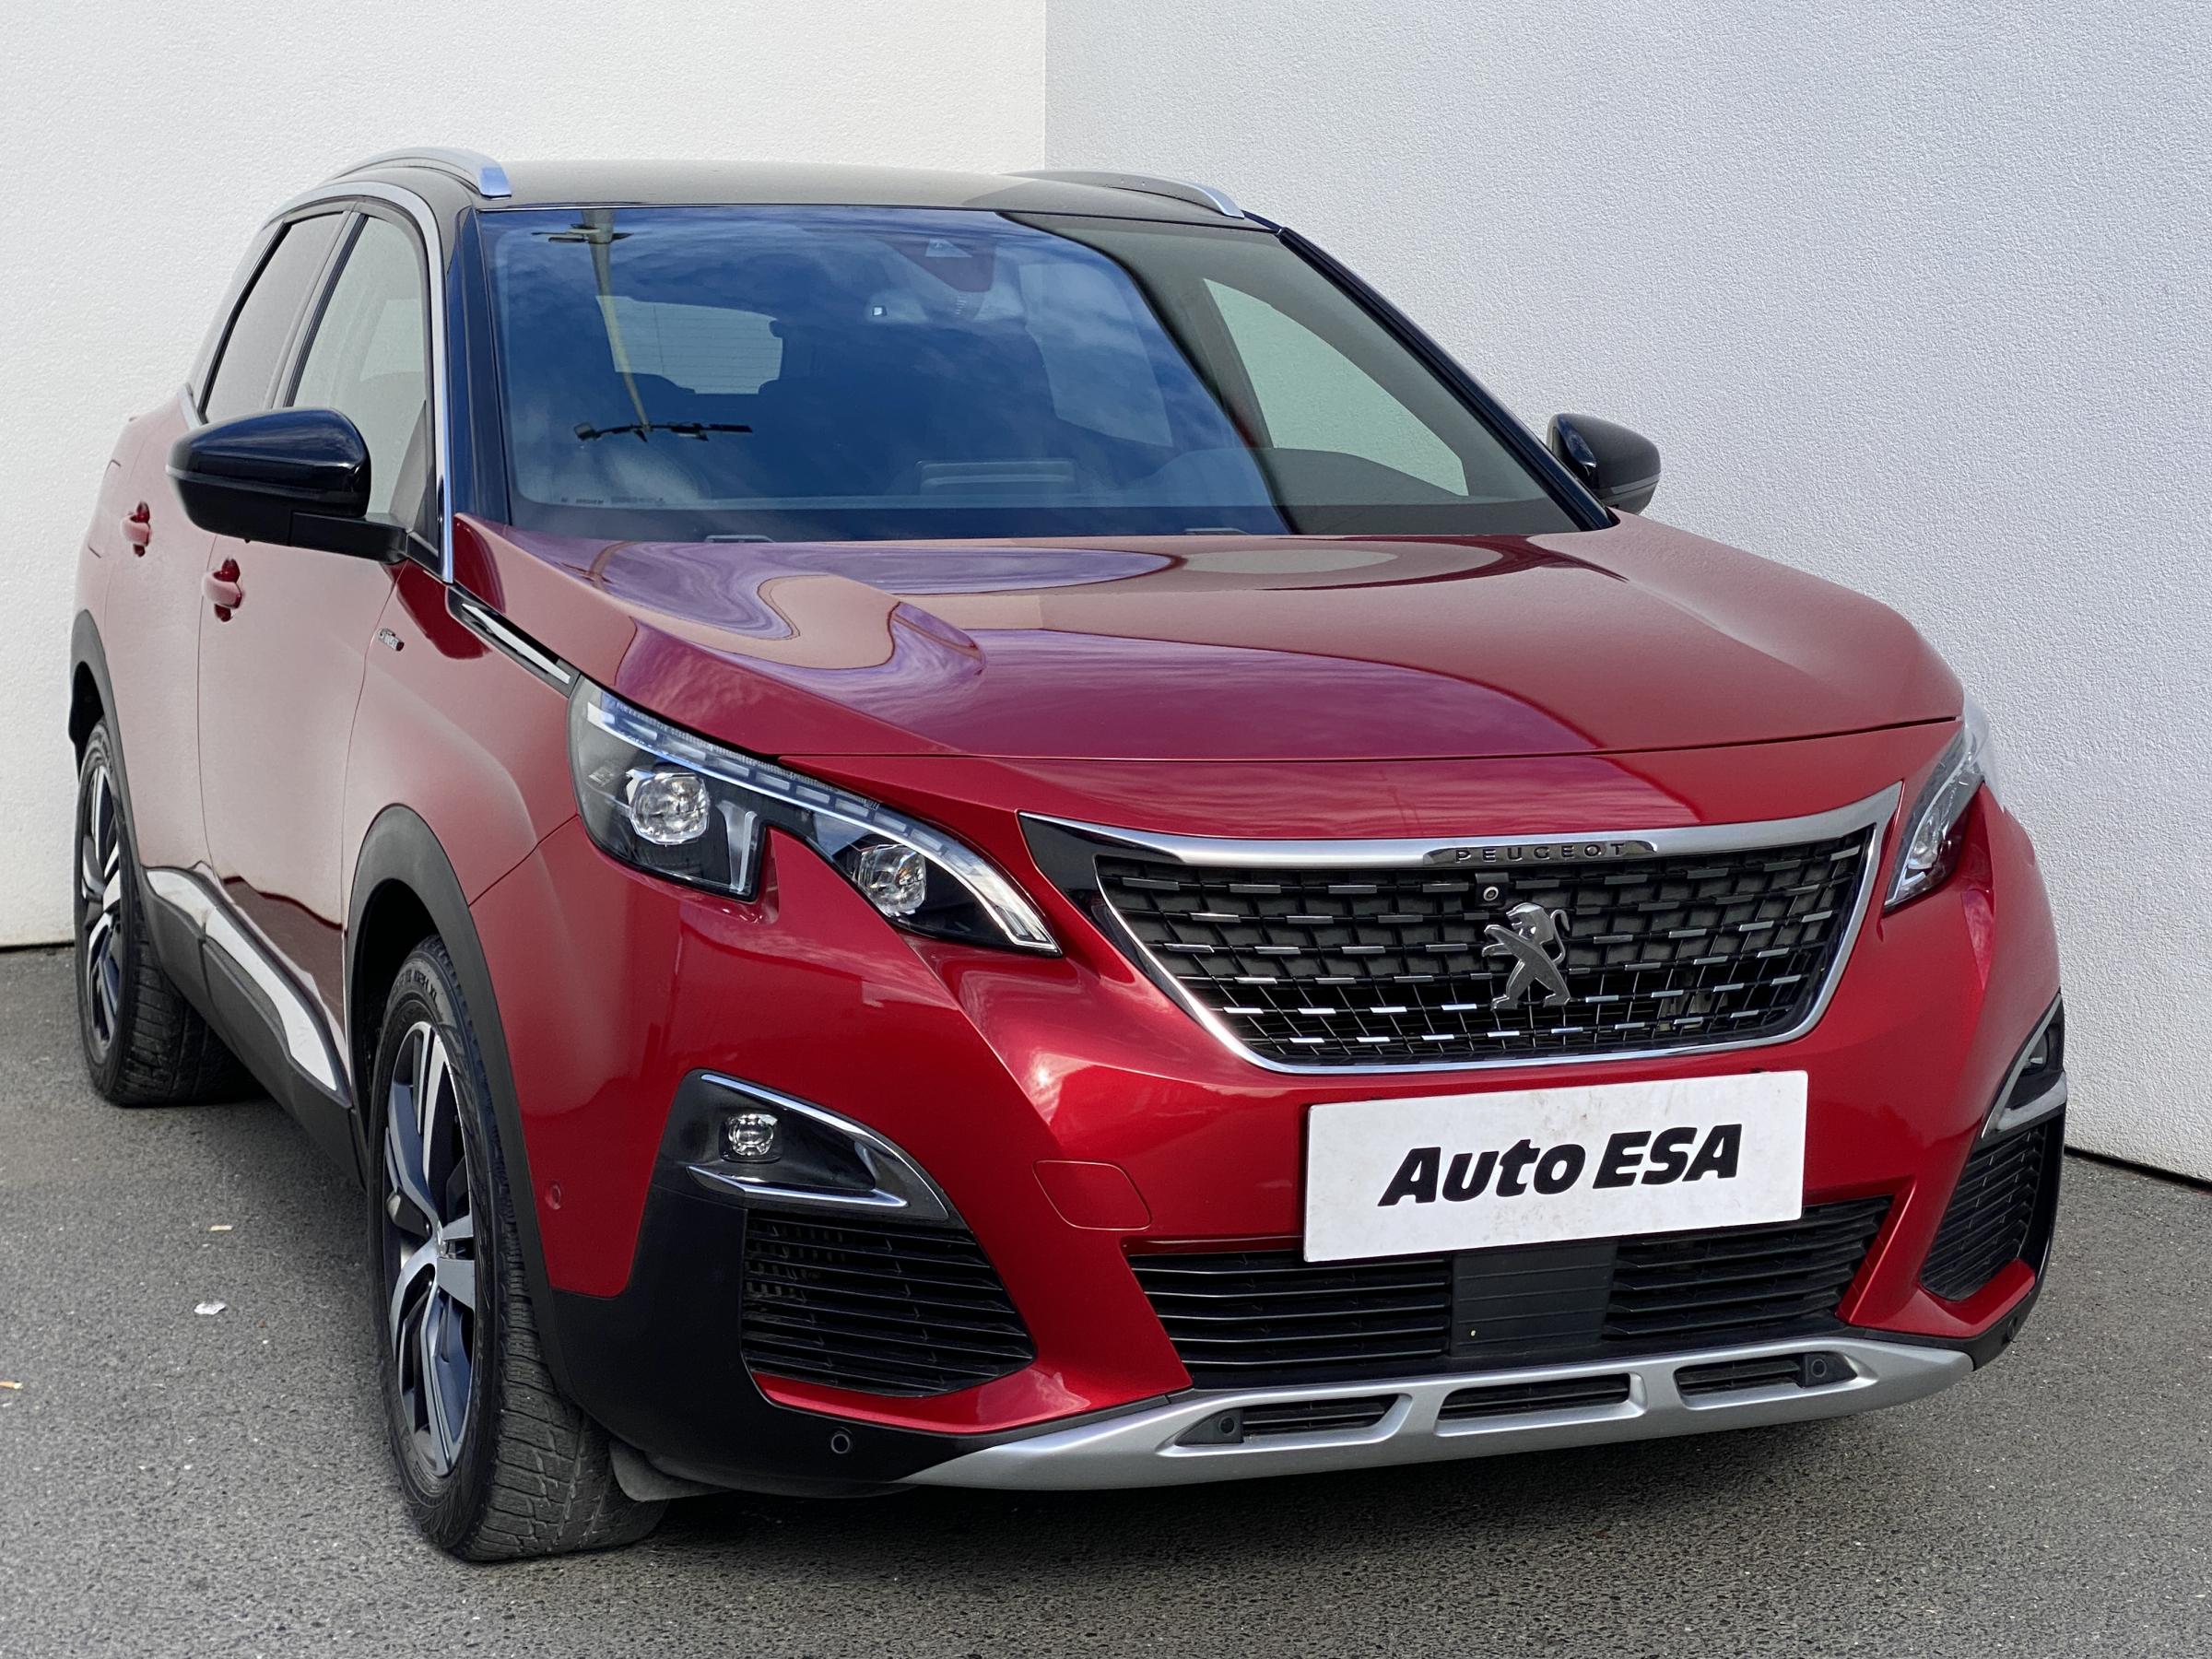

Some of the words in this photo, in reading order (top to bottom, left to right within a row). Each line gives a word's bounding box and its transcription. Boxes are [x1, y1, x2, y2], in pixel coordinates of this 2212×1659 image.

[1455, 842, 1626, 863] PEUGEOT
[1377, 1138, 1586, 1206] Auto
[1593, 1124, 1742, 1190] ESA
